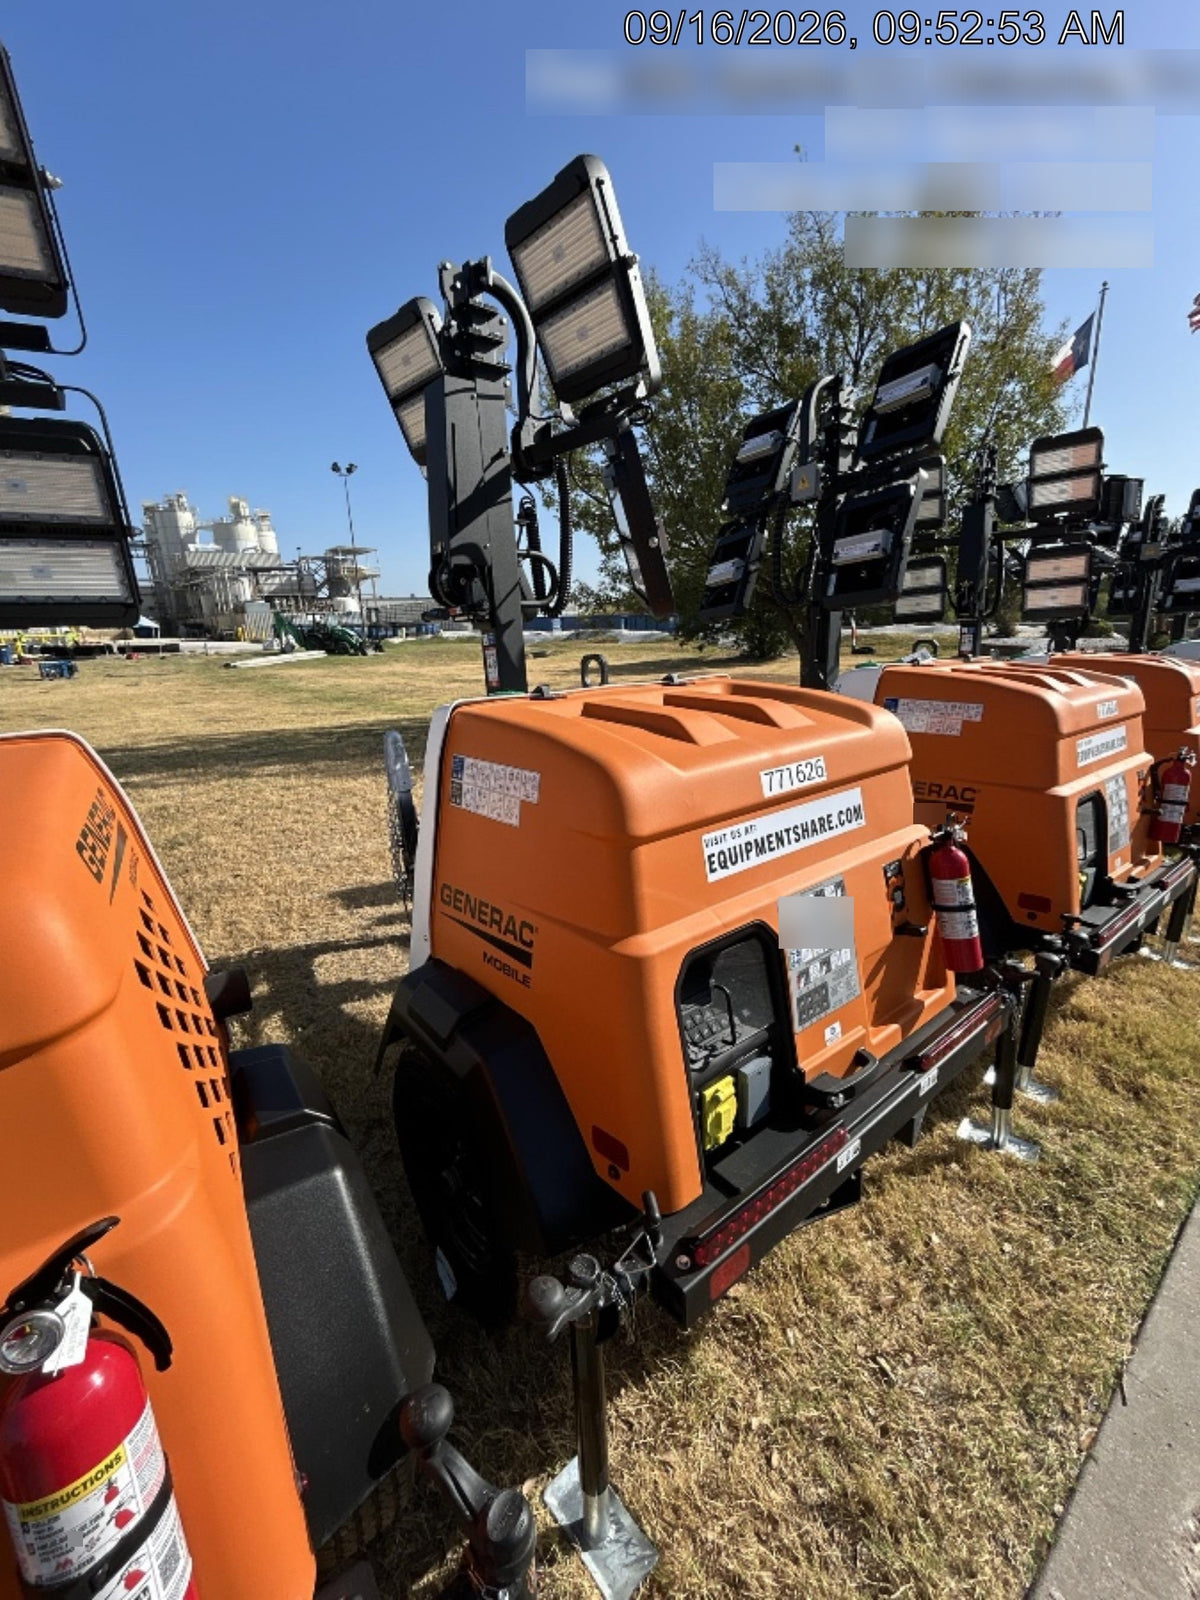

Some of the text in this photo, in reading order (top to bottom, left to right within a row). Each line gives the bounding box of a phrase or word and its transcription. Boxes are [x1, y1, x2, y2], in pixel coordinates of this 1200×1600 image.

[763, 759, 824, 792] 771626
[914, 781, 976, 802] ERAC
[703, 833, 727, 848] VISIT
[730, 828, 742, 840] US
[707, 803, 863, 874] EQUIPMENTSHARE.COM
[440, 882, 534, 949] GENERAC
[483, 951, 531, 989] MOBILE
[21, 1453, 122, 1517] INSTRUCTIONS
